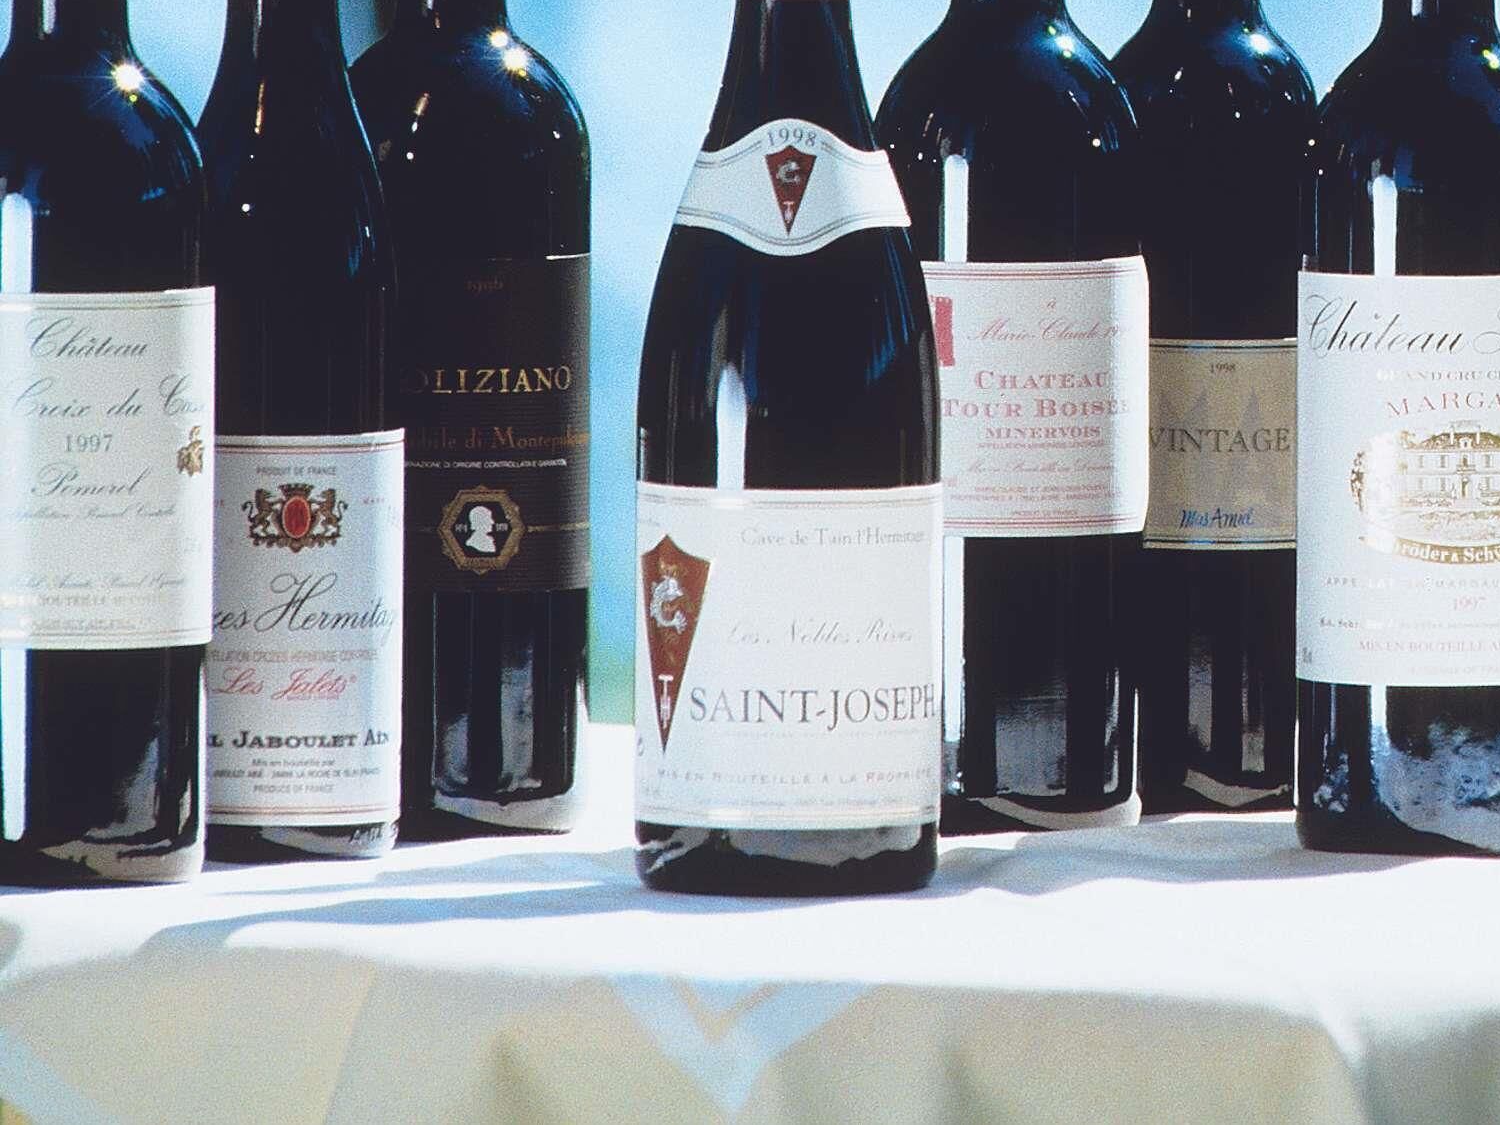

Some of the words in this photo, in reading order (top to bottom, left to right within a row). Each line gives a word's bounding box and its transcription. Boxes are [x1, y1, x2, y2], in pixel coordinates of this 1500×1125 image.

[765, 127, 818, 148] 1998
[25, 316, 149, 359] Château
[1304, 294, 1466, 359] Château
[1209, 362, 1237, 374] 1998
[974, 370, 1113, 390] CHATEAU
[106, 388, 143, 417] du
[64, 433, 113, 453] 1997
[984, 426, 1105, 440] MINERVOIS
[1149, 427, 1291, 453] VINTAGE
[30, 462, 151, 497] Pomerol
[740, 527, 786, 546] Cave
[790, 528, 810, 546] de
[213, 667, 264, 695] Les
[690, 683, 935, 731] SAINT-JOSEPH
[233, 730, 358, 750] JABOULET
